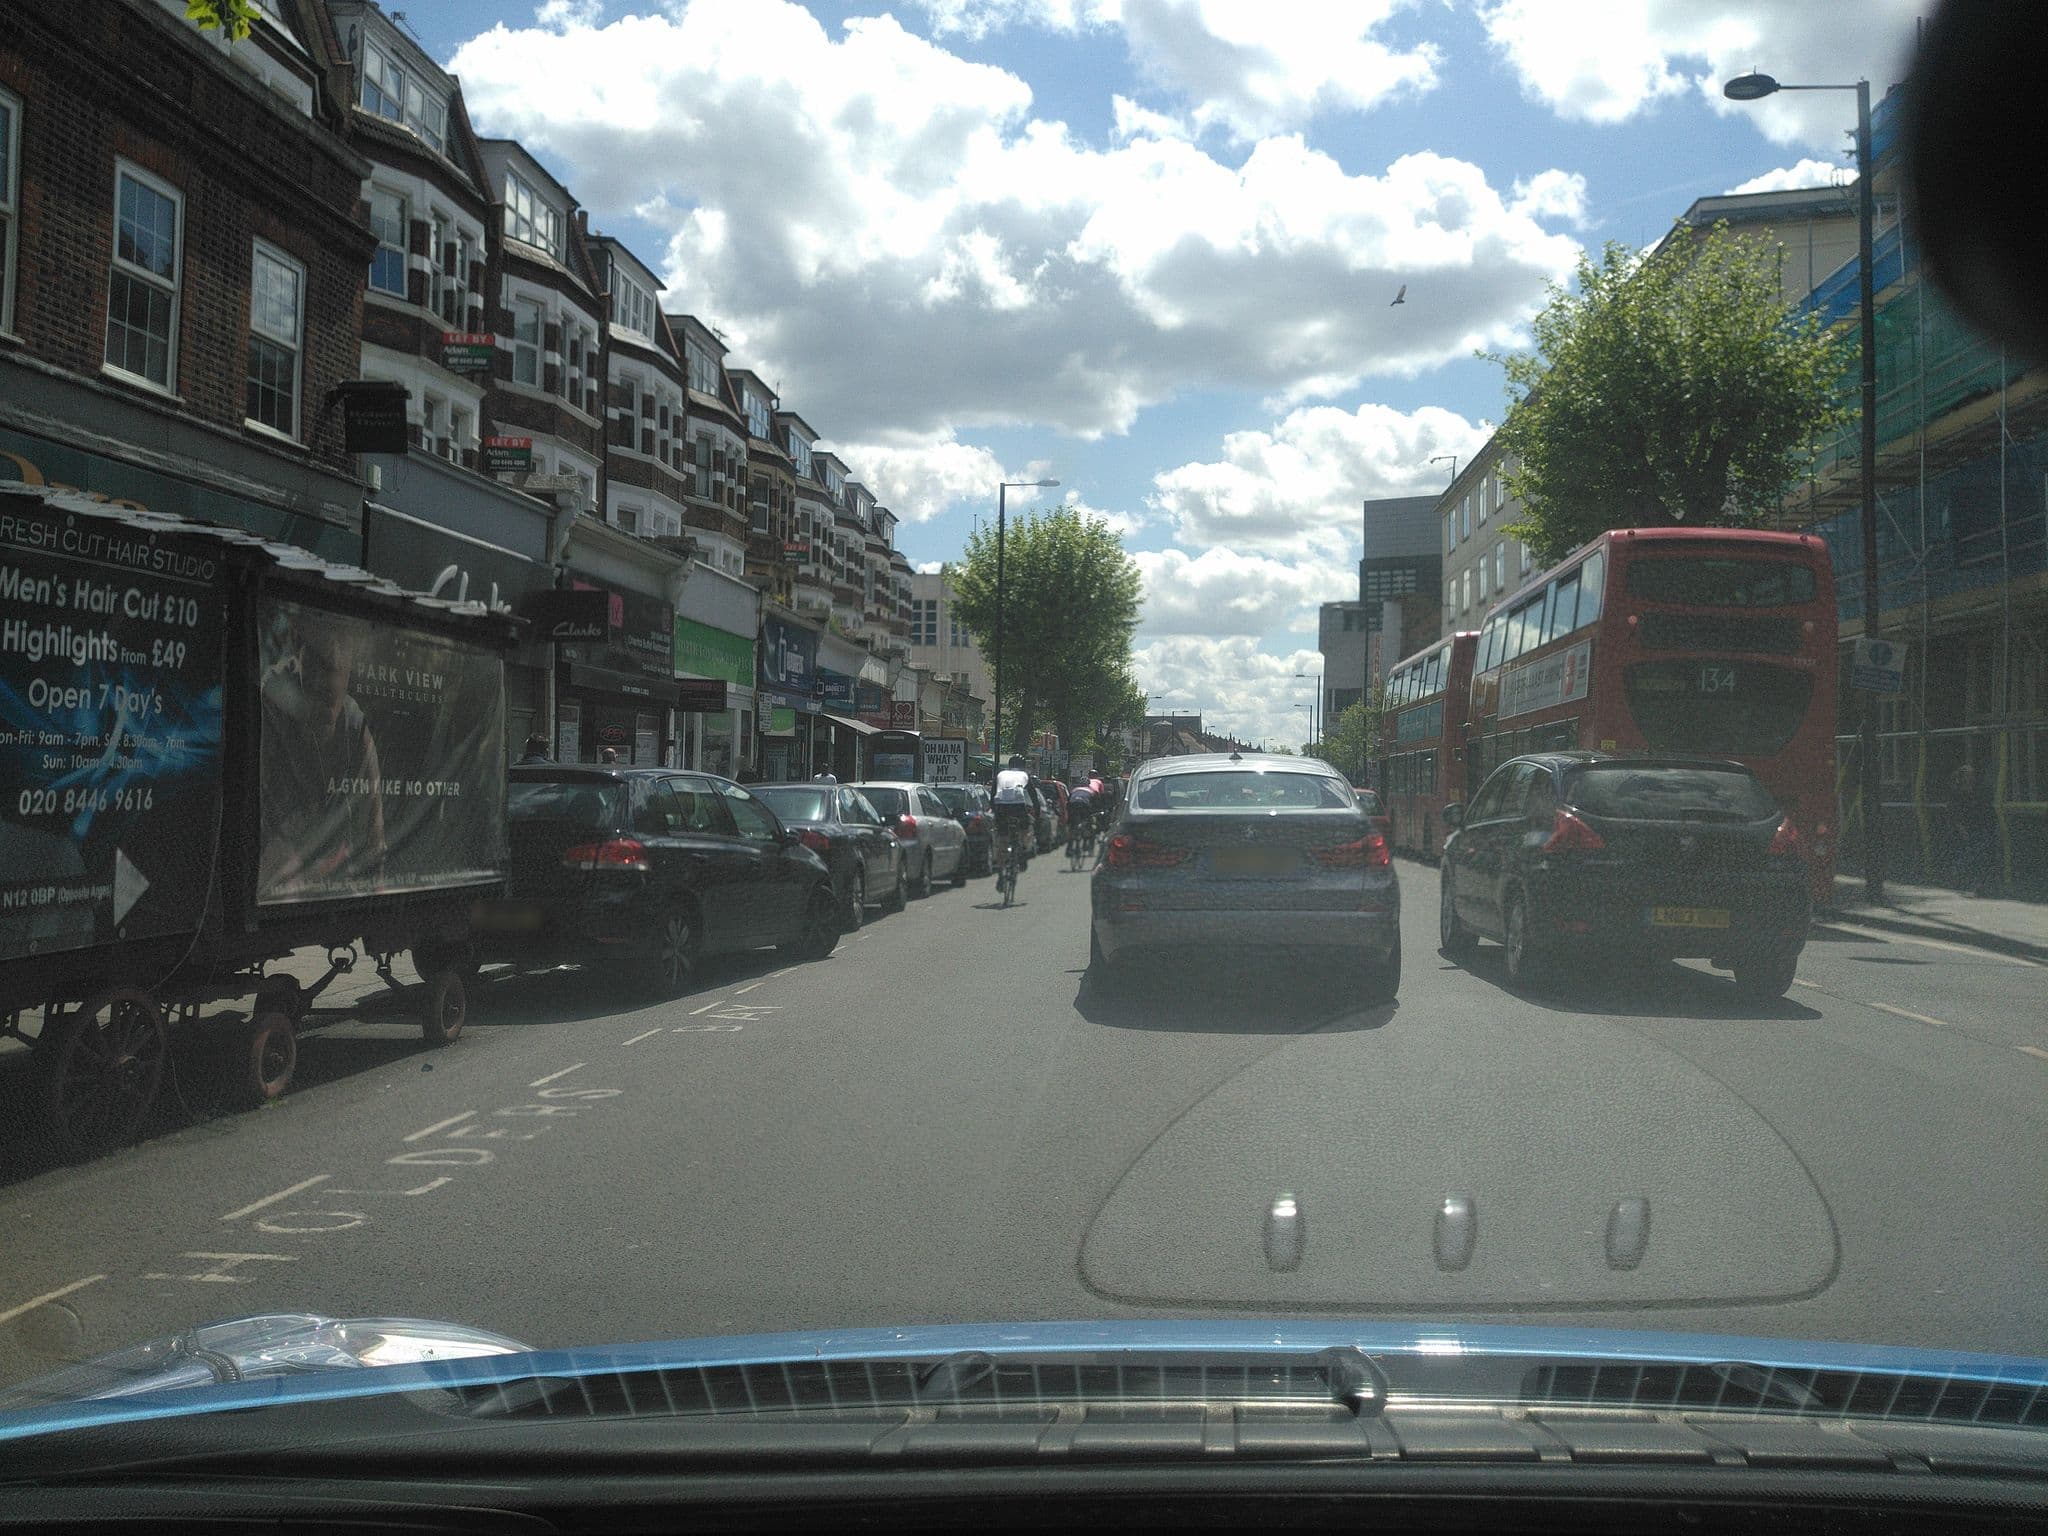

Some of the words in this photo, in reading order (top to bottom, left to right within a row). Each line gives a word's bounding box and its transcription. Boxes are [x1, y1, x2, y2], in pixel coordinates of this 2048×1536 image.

[449, 334, 467, 344] LET
[473, 334, 486, 344] BY
[491, 438, 508, 447] LET
[512, 438, 525, 447] BY
[63, 529, 105, 557] CUT
[107, 539, 149, 567] HAIR
[152, 549, 215, 579] STUDIO
[0, 565, 67, 608] Men's
[74, 580, 119, 614] Hair
[124, 588, 160, 621] Cut
[164, 595, 198, 628] £10
[552, 621, 601, 638] Clarks
[3, 619, 119, 667] Highlights
[152, 638, 187, 670] £49
[357, 664, 399, 684] PARK
[405, 669, 444, 690] VIEW
[1701, 668, 1737, 692] 134
[28, 677, 92, 714] Open
[99, 683, 109, 711] 7
[115, 684, 163, 719] Day's
[39, 730, 64, 746] 9am
[925, 743, 936, 753] OH
[938, 743, 949, 753] NA
[950, 743, 962, 754] NA
[42, 754, 67, 769] Sun:
[928, 754, 959, 765] WHAT'S
[937, 765, 949, 775] MY
[327, 777, 336, 793] A
[341, 777, 369, 794] GYM
[405, 780, 422, 795] NO
[426, 780, 460, 796] OTHER
[20, 789, 57, 815] 020
[64, 788, 108, 813] 8446
[116, 788, 153, 811] 9616
[3, 889, 28, 909] N12
